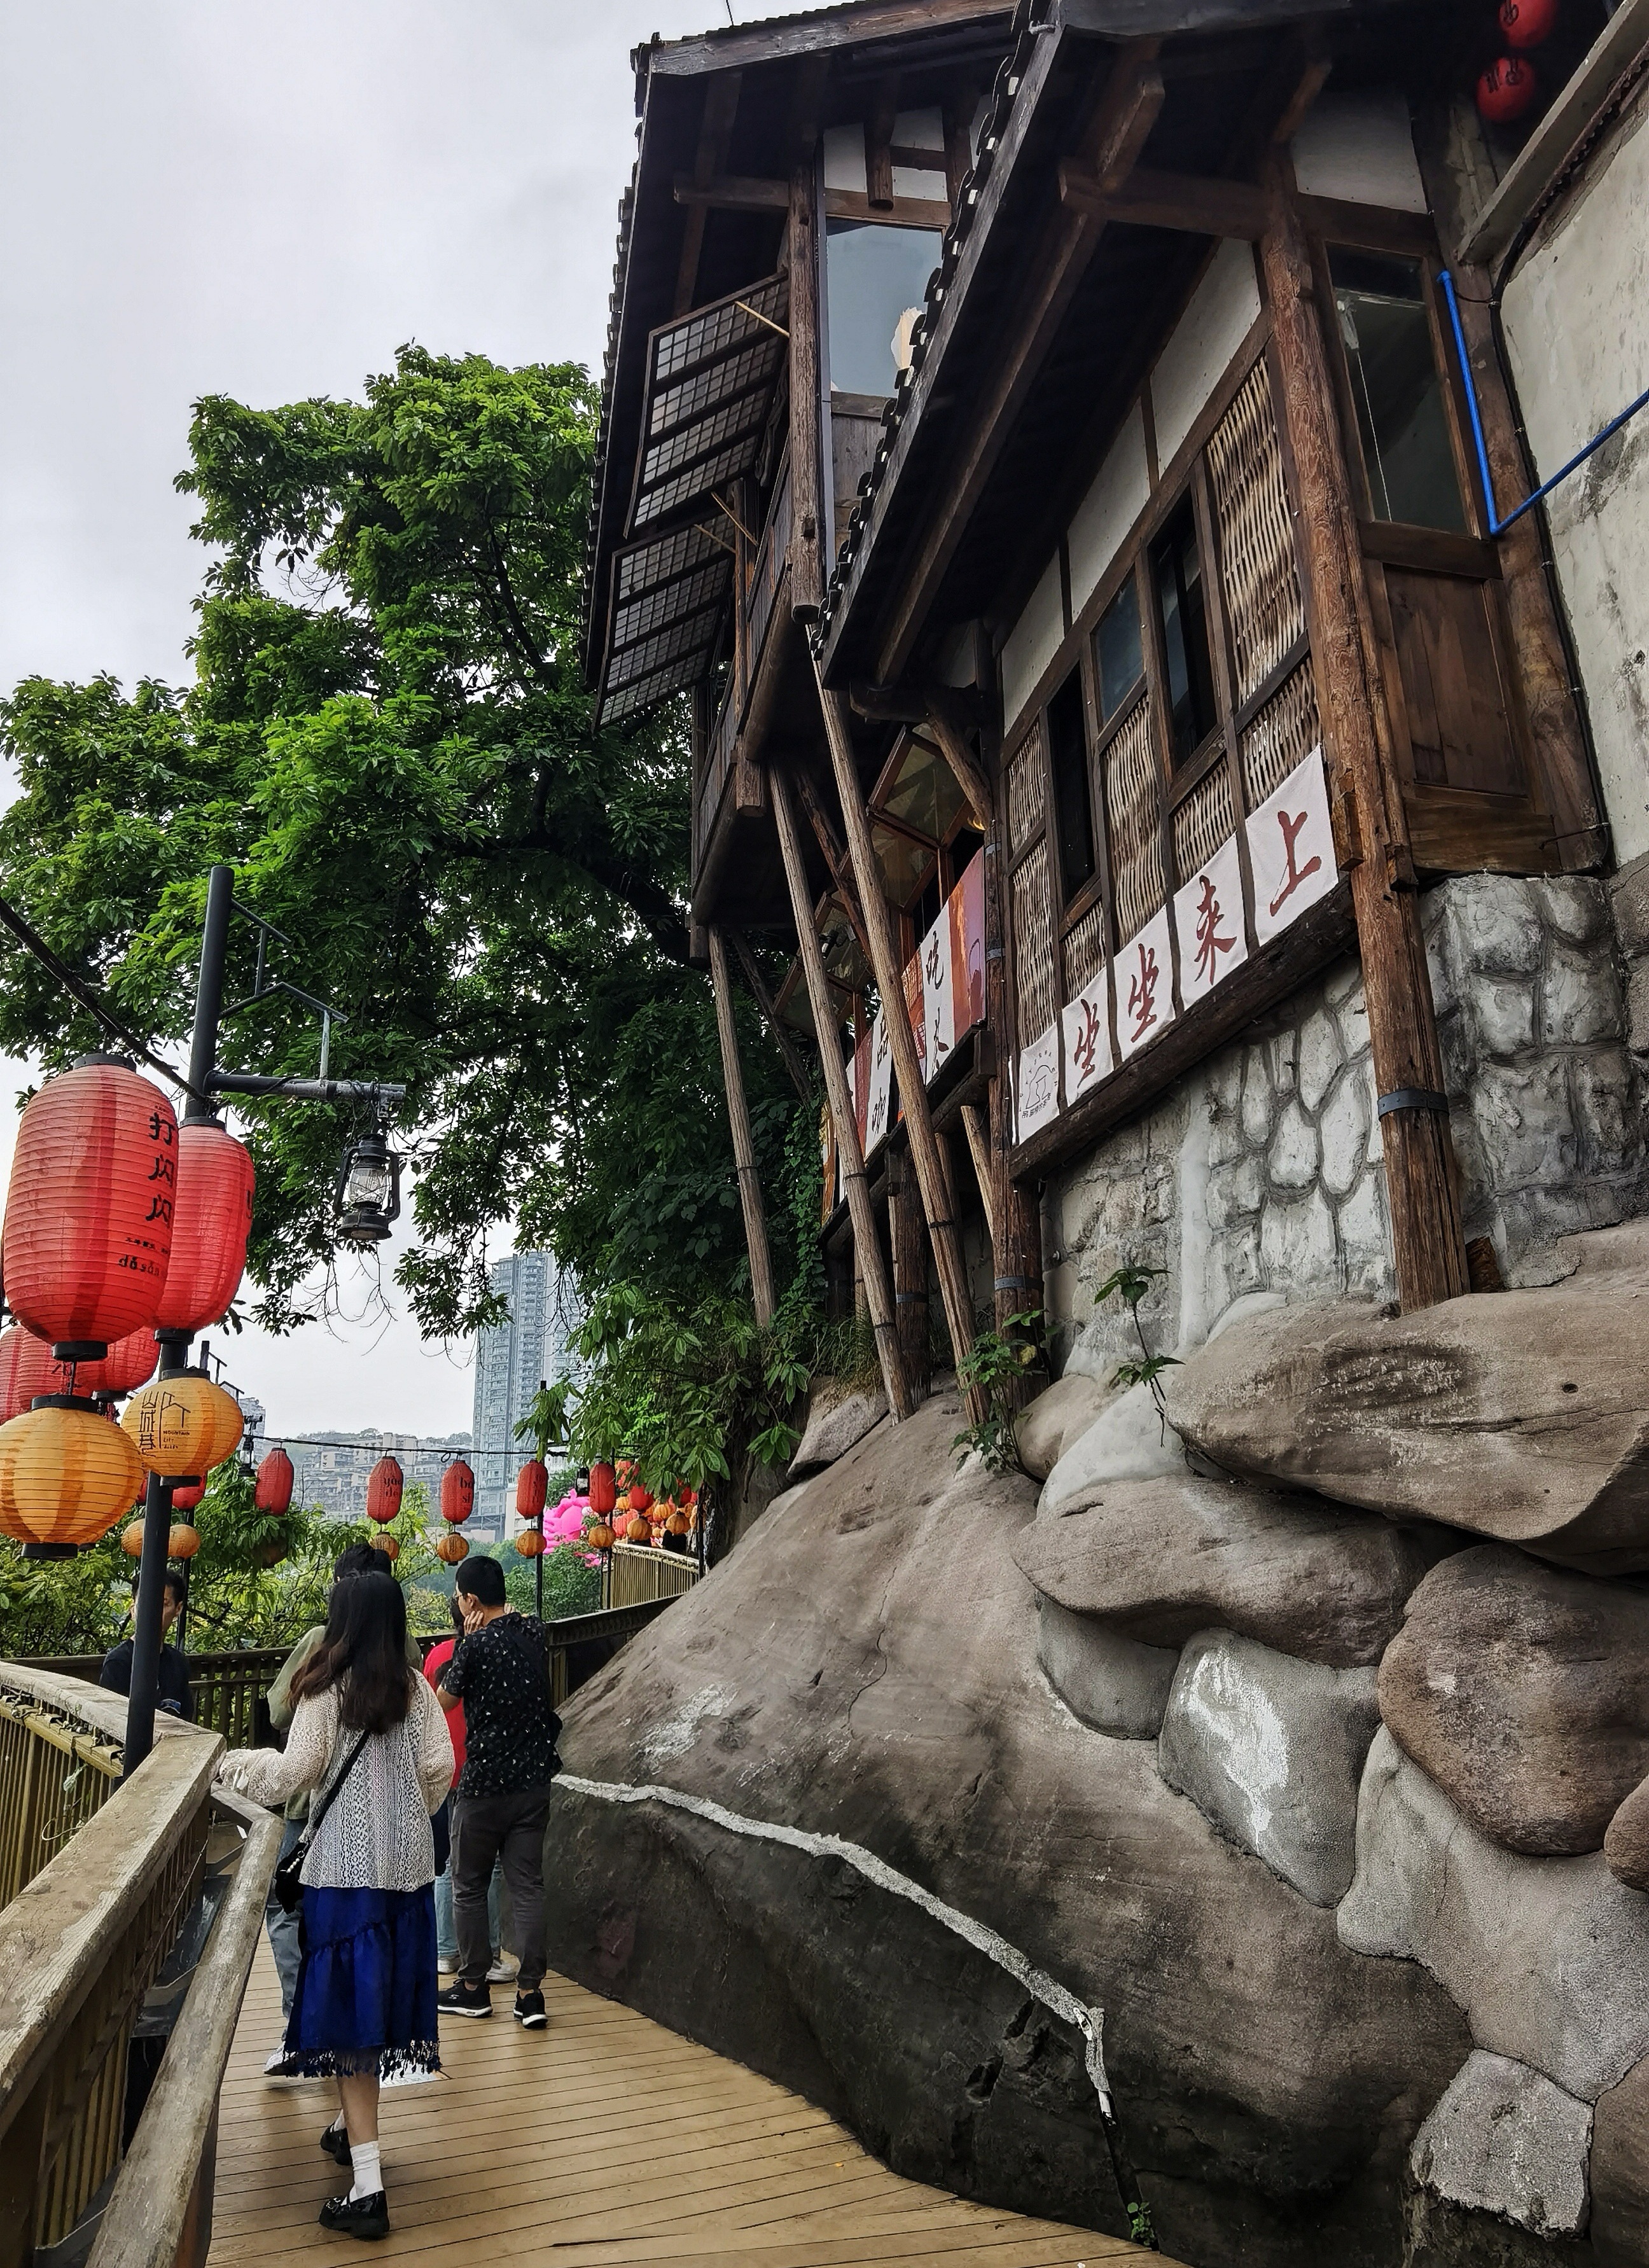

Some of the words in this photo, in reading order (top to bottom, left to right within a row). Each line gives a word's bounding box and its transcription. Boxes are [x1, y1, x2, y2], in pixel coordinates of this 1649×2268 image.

[146, 1111, 176, 1229] 打闪闪
[138, 1391, 157, 1458] 山城巷
